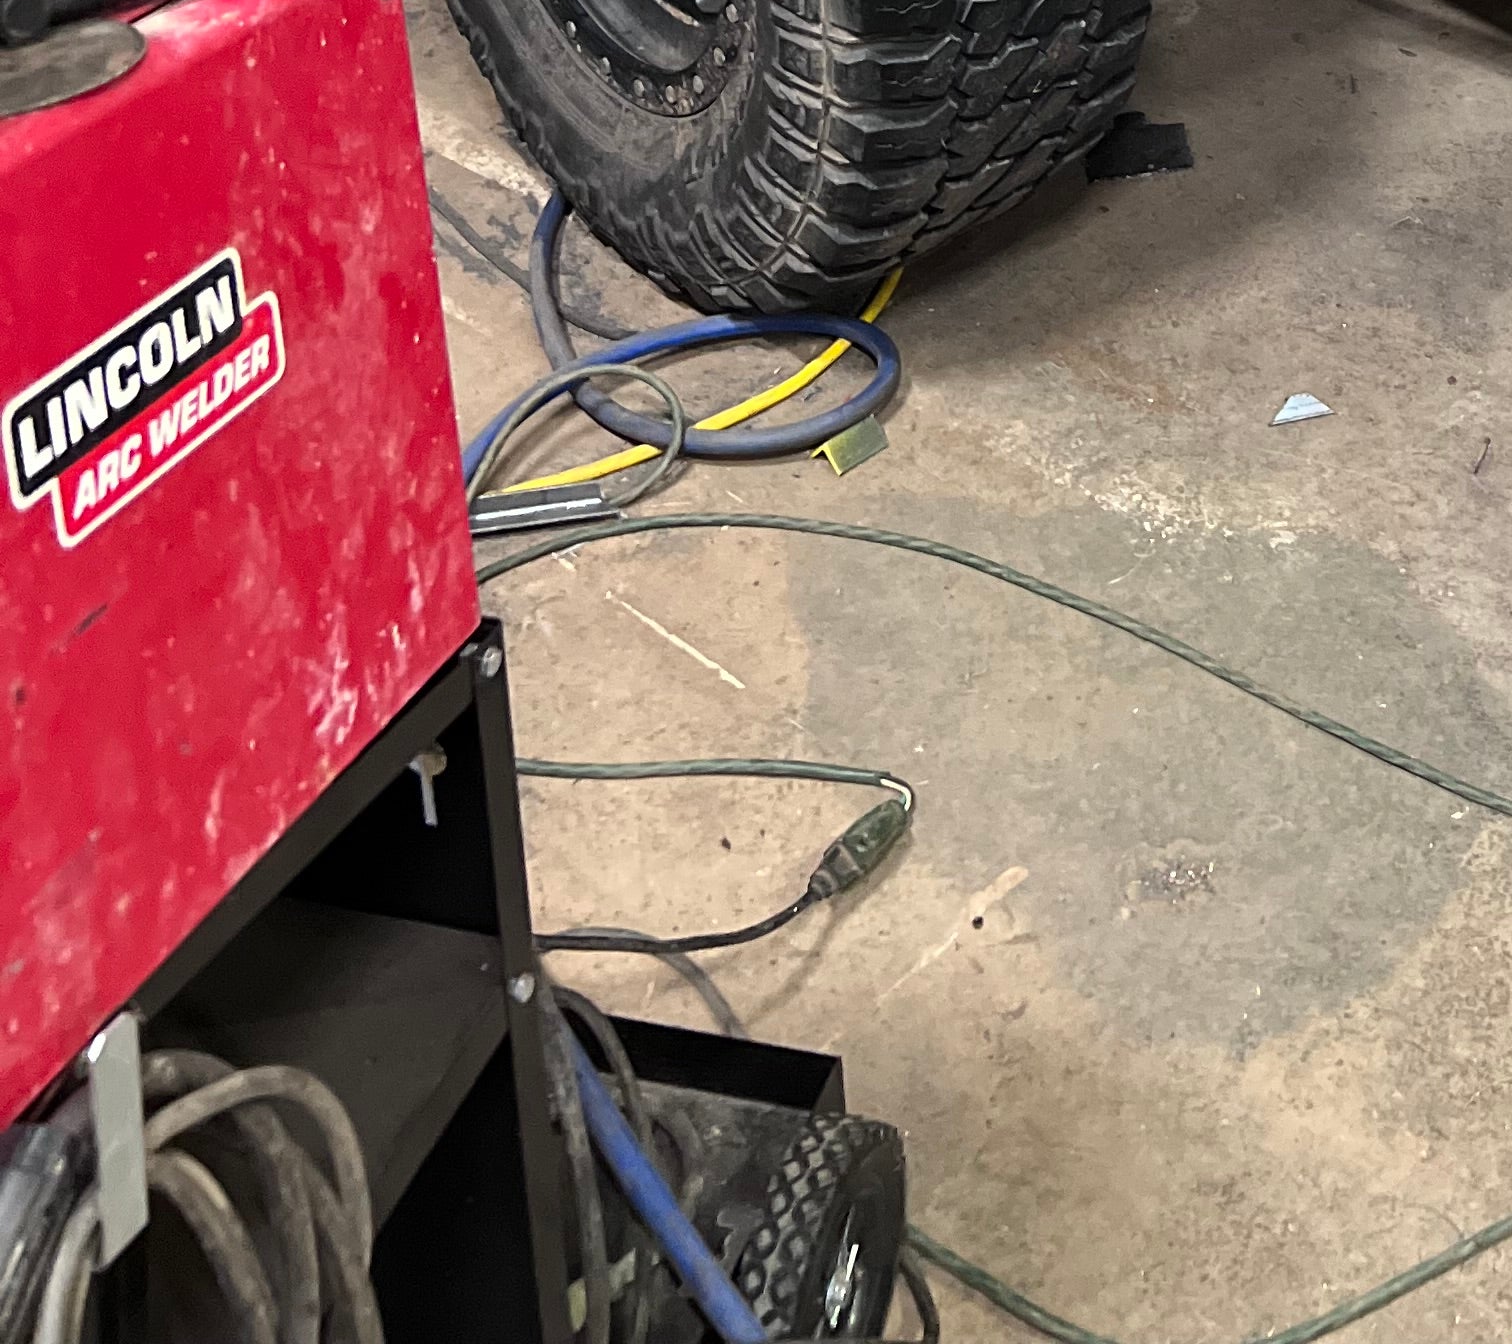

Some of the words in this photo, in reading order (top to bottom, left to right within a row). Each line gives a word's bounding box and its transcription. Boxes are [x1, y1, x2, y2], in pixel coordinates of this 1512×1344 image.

[18, 274, 236, 479] LINCOLN
[72, 432, 144, 521] ARC
[147, 333, 271, 458] WELDER
